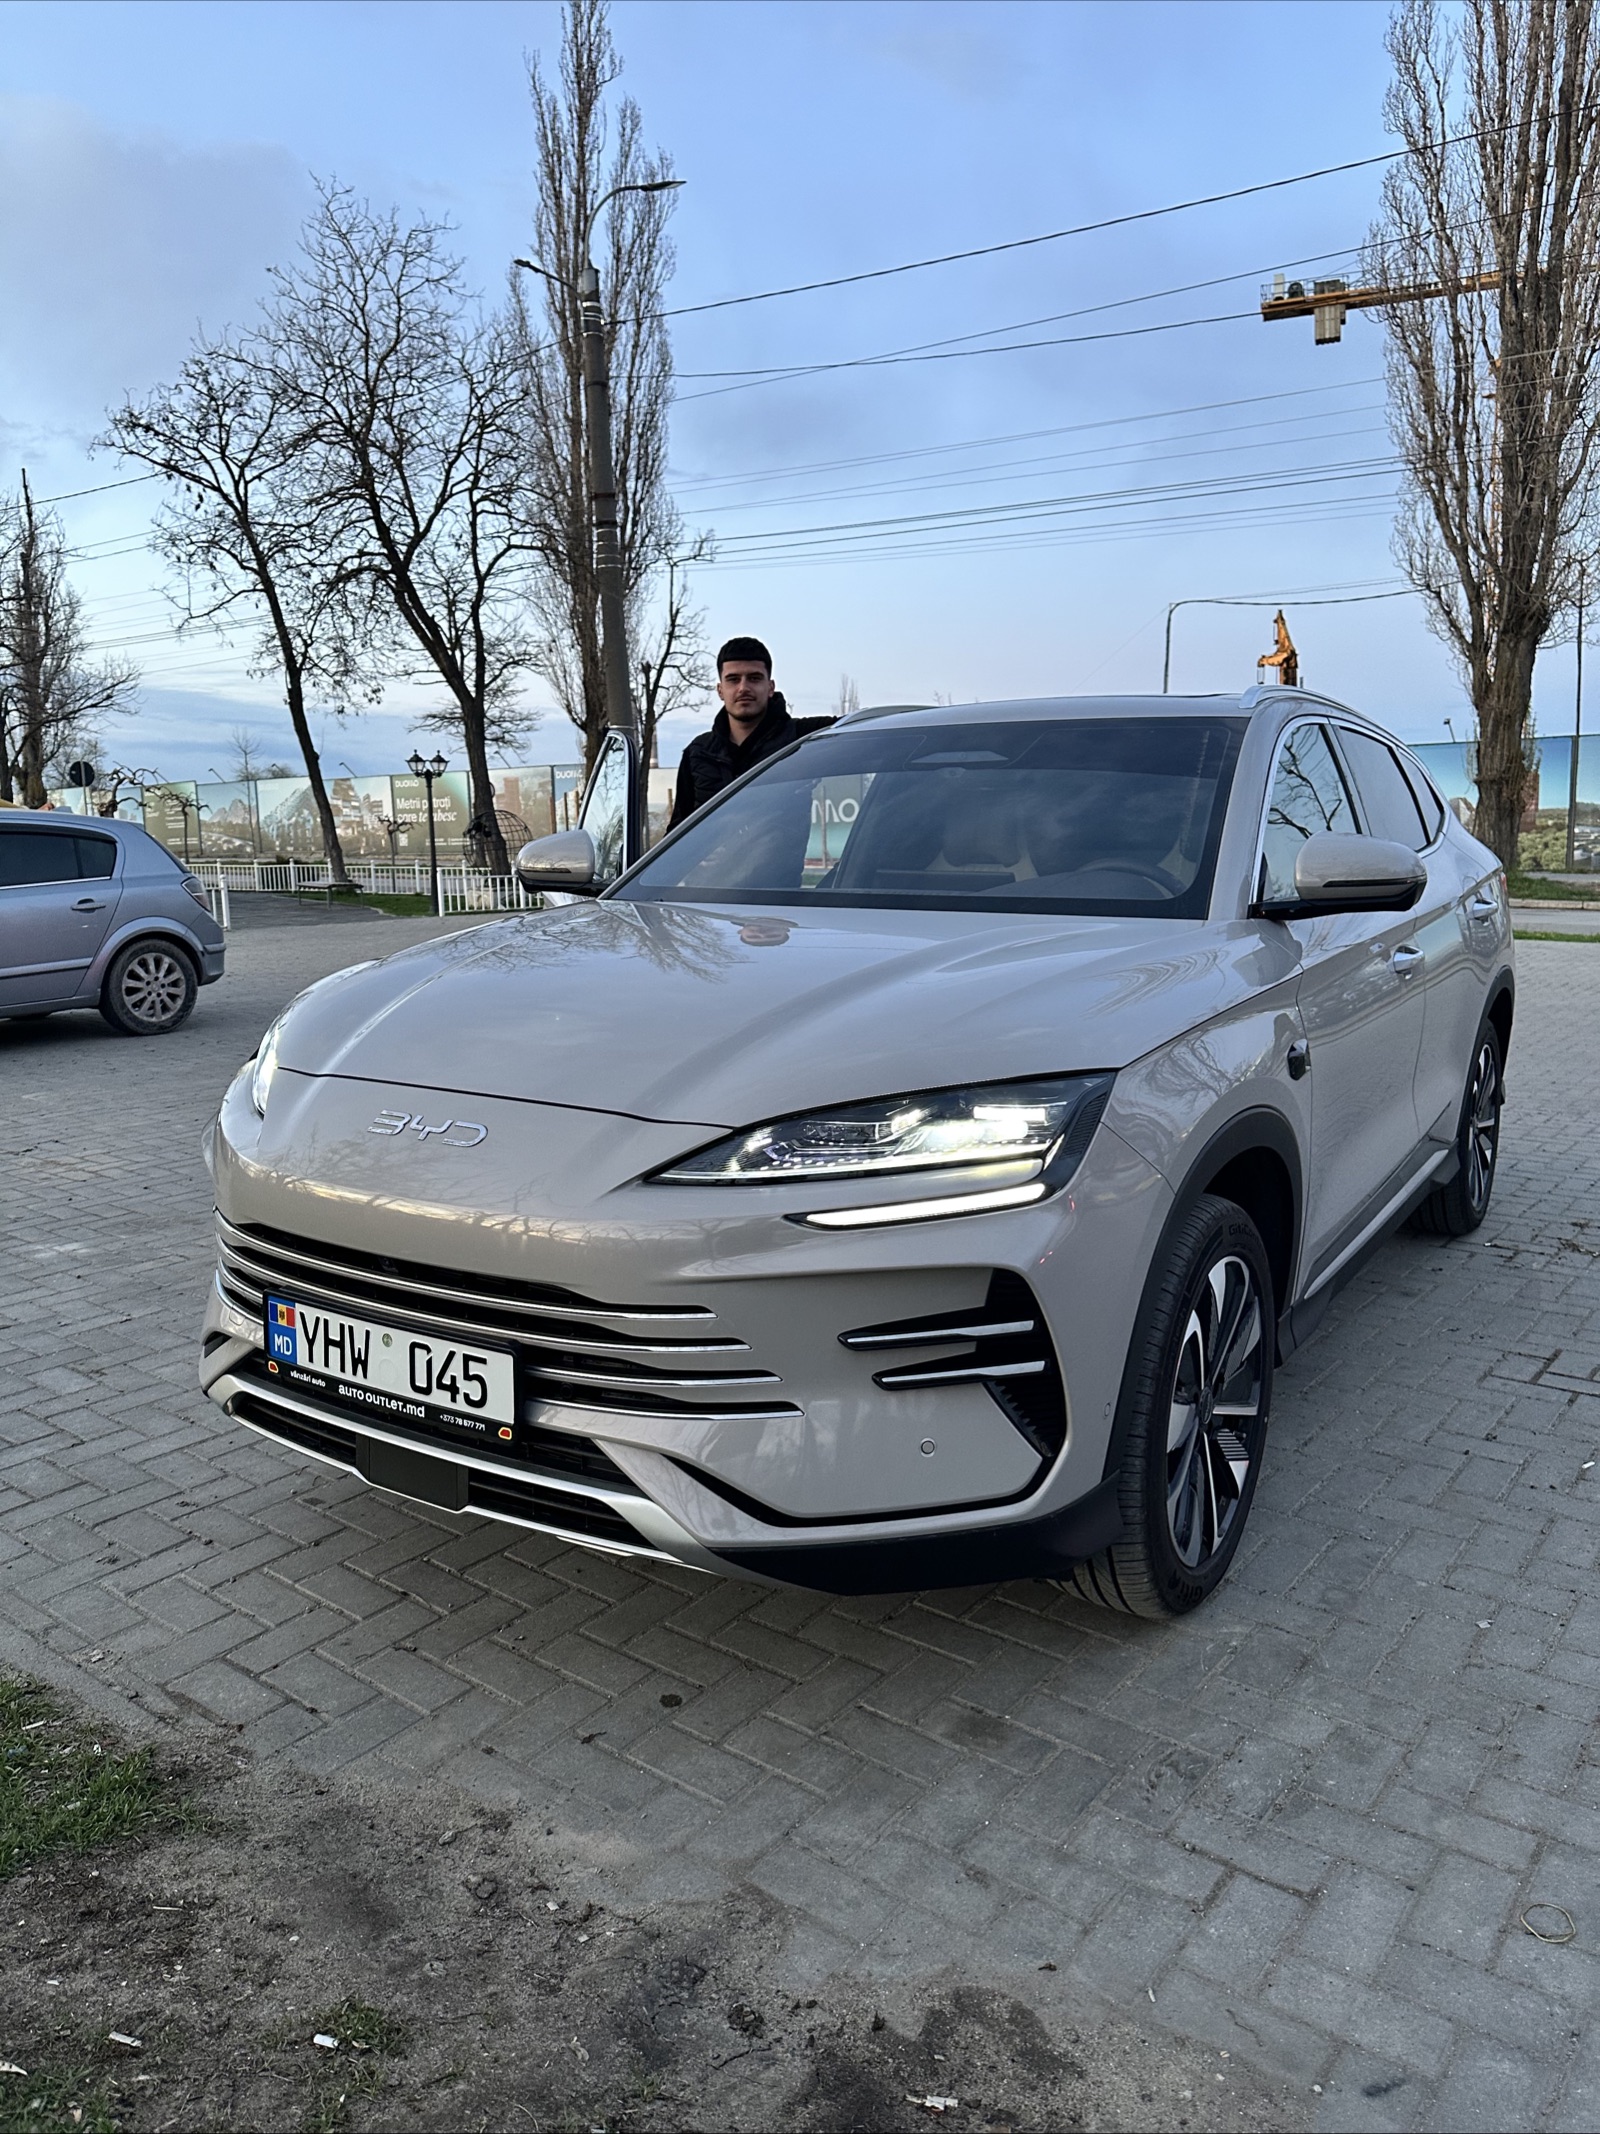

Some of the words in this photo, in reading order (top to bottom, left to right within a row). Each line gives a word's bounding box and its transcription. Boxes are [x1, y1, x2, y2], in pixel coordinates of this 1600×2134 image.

[396, 797, 420, 809] Metrii
[421, 795, 451, 811] ptrați
[432, 809, 457, 822] ubesc
[367, 1109, 489, 1147] BYD
[274, 1333, 293, 1356] MD
[299, 1311, 371, 1380] YHW
[409, 1341, 488, 1409] 045
[311, 1377, 326, 1388] auto
